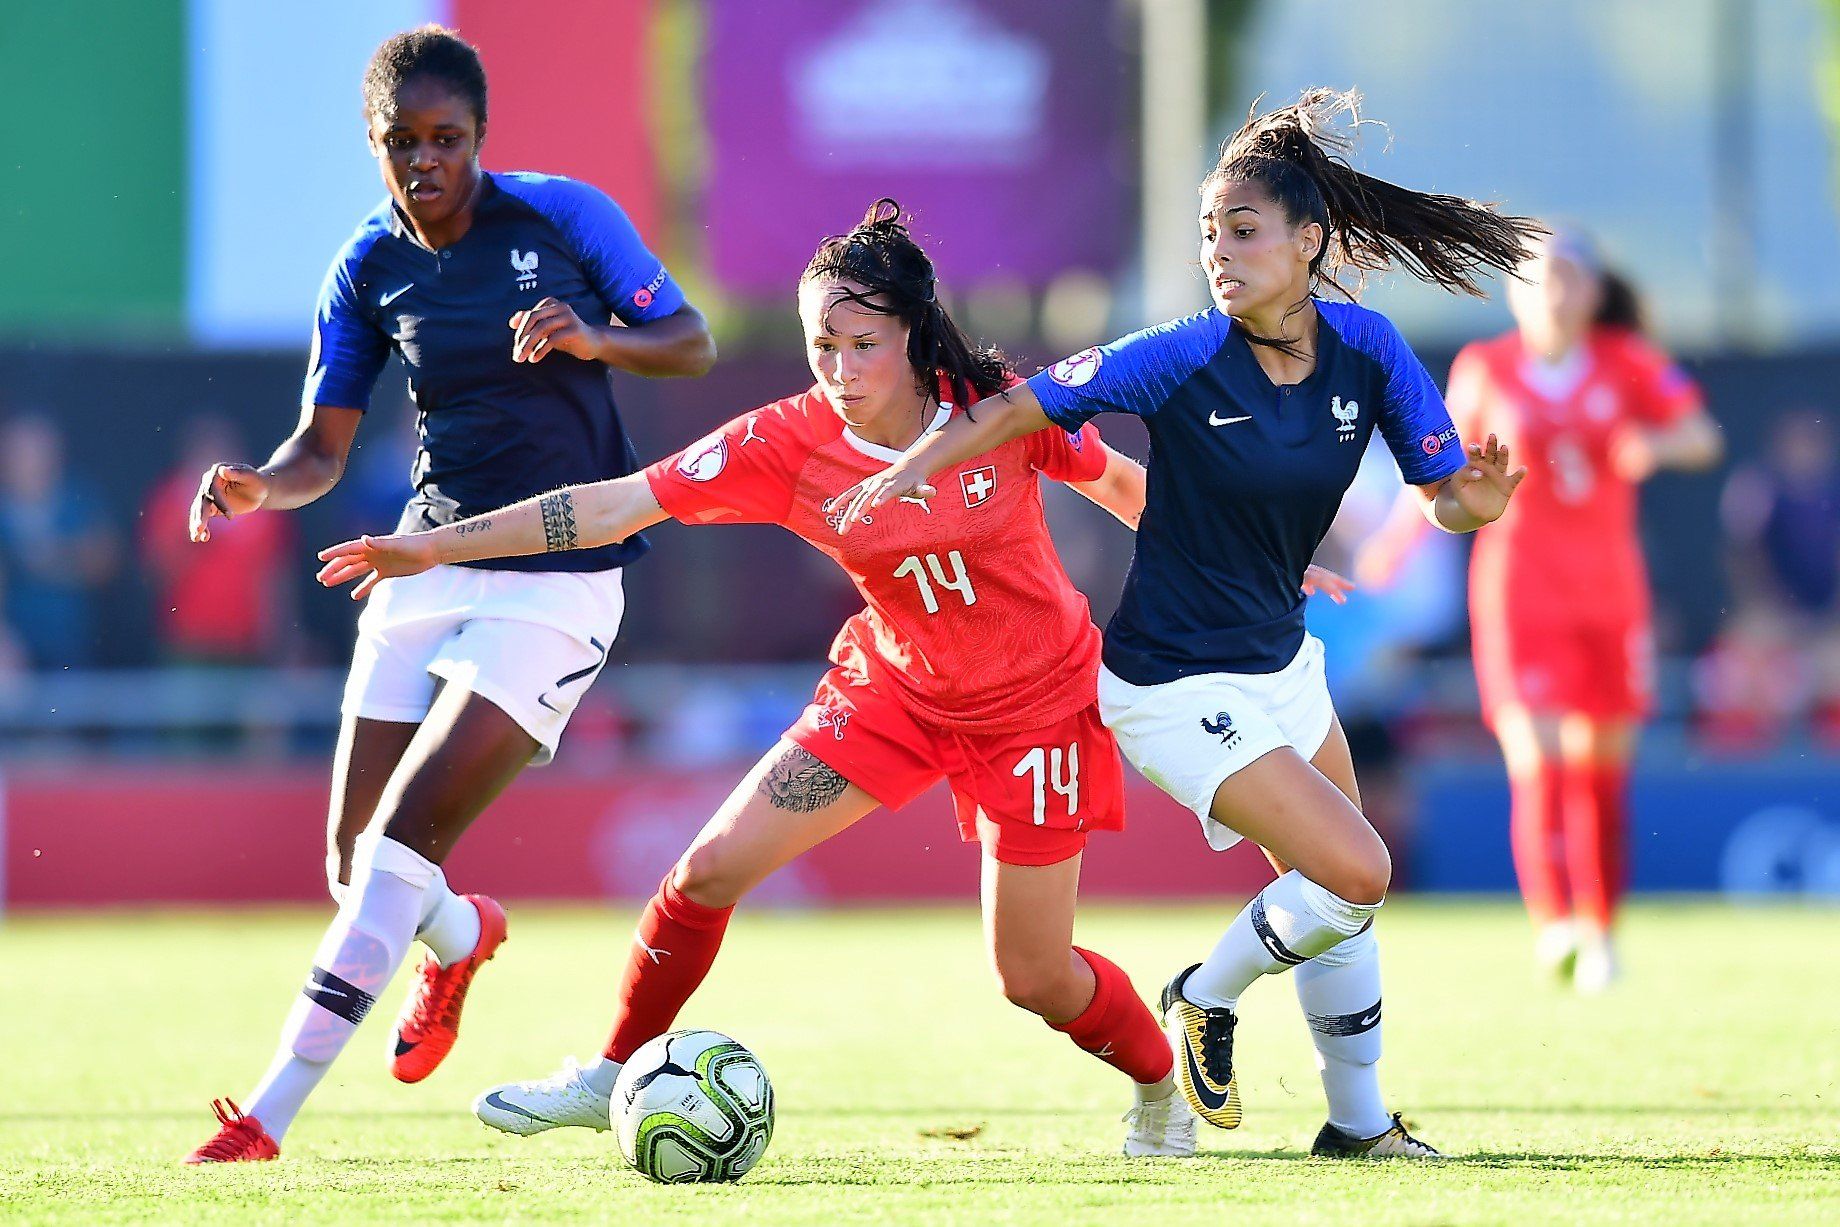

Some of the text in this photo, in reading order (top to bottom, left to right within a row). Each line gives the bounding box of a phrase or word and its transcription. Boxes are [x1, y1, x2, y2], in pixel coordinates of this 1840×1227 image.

[892, 550, 977, 614] 14
[556, 636, 605, 688] 7
[1012, 741, 1079, 826] 14
[680, 1093, 695, 1107] FIFA
